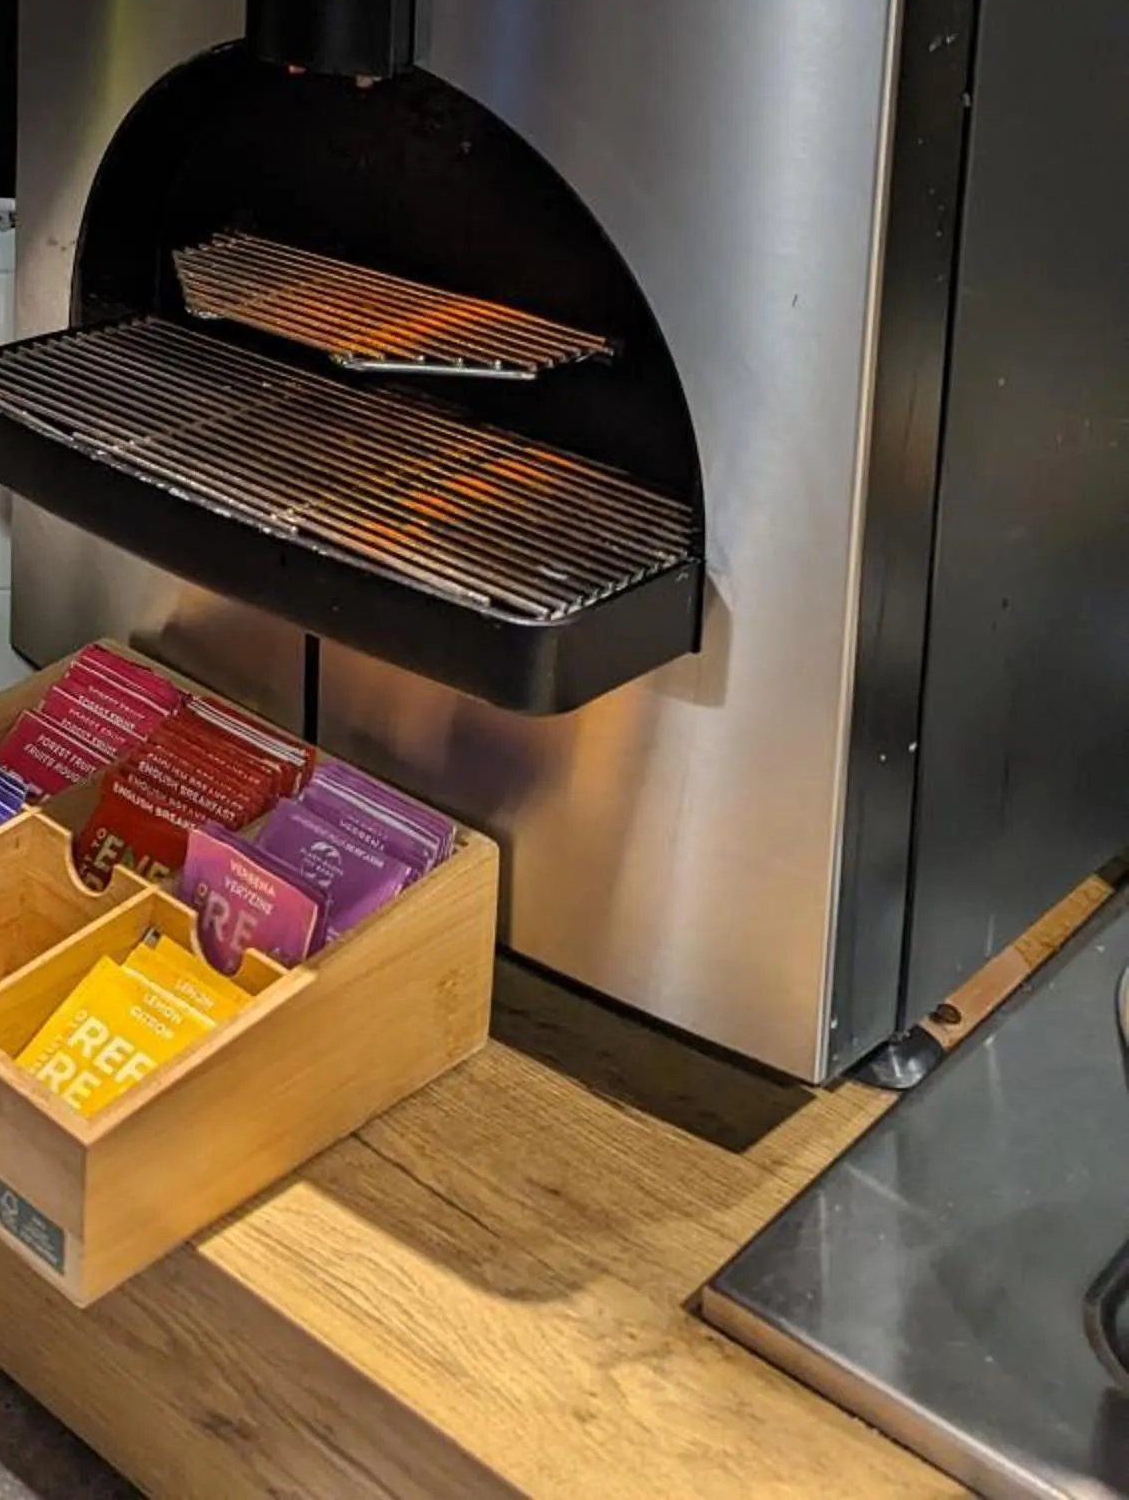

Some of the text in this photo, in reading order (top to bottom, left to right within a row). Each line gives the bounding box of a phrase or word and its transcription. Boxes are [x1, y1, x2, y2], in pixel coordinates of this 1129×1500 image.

[37, 734, 98, 774] FOREST FRUIT
[139, 760, 179, 791] ENGLISH
[179, 782, 236, 822] BREAKFAST
[144, 994, 183, 1024] LEMON
